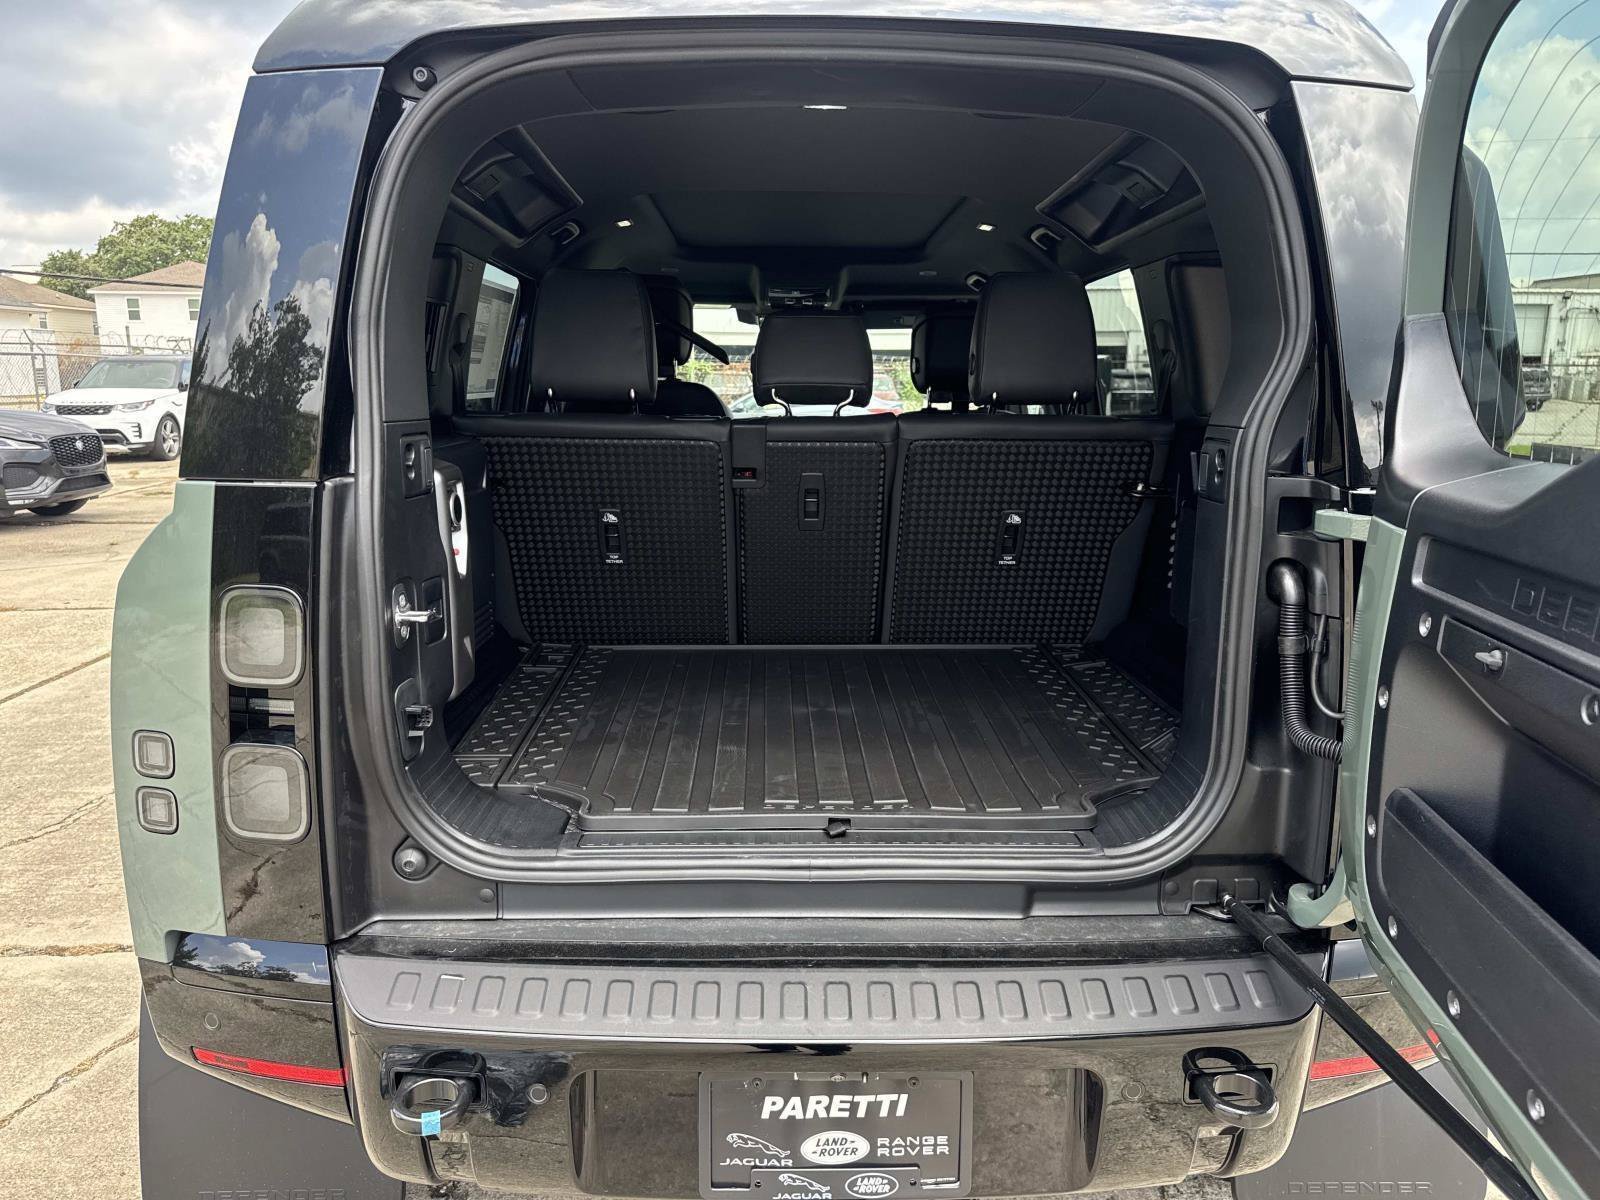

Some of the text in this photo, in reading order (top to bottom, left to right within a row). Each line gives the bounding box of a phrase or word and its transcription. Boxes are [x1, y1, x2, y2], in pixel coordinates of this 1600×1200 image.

[761, 1093, 908, 1120] PARETTI
[877, 1135, 949, 1146] RANGE
[877, 1145, 950, 1157] ROVER
[719, 1157, 793, 1167] JAGUAR
[1287, 1181, 1433, 1194] DEFENDER
[772, 1192, 832, 1200] JAGUAR
